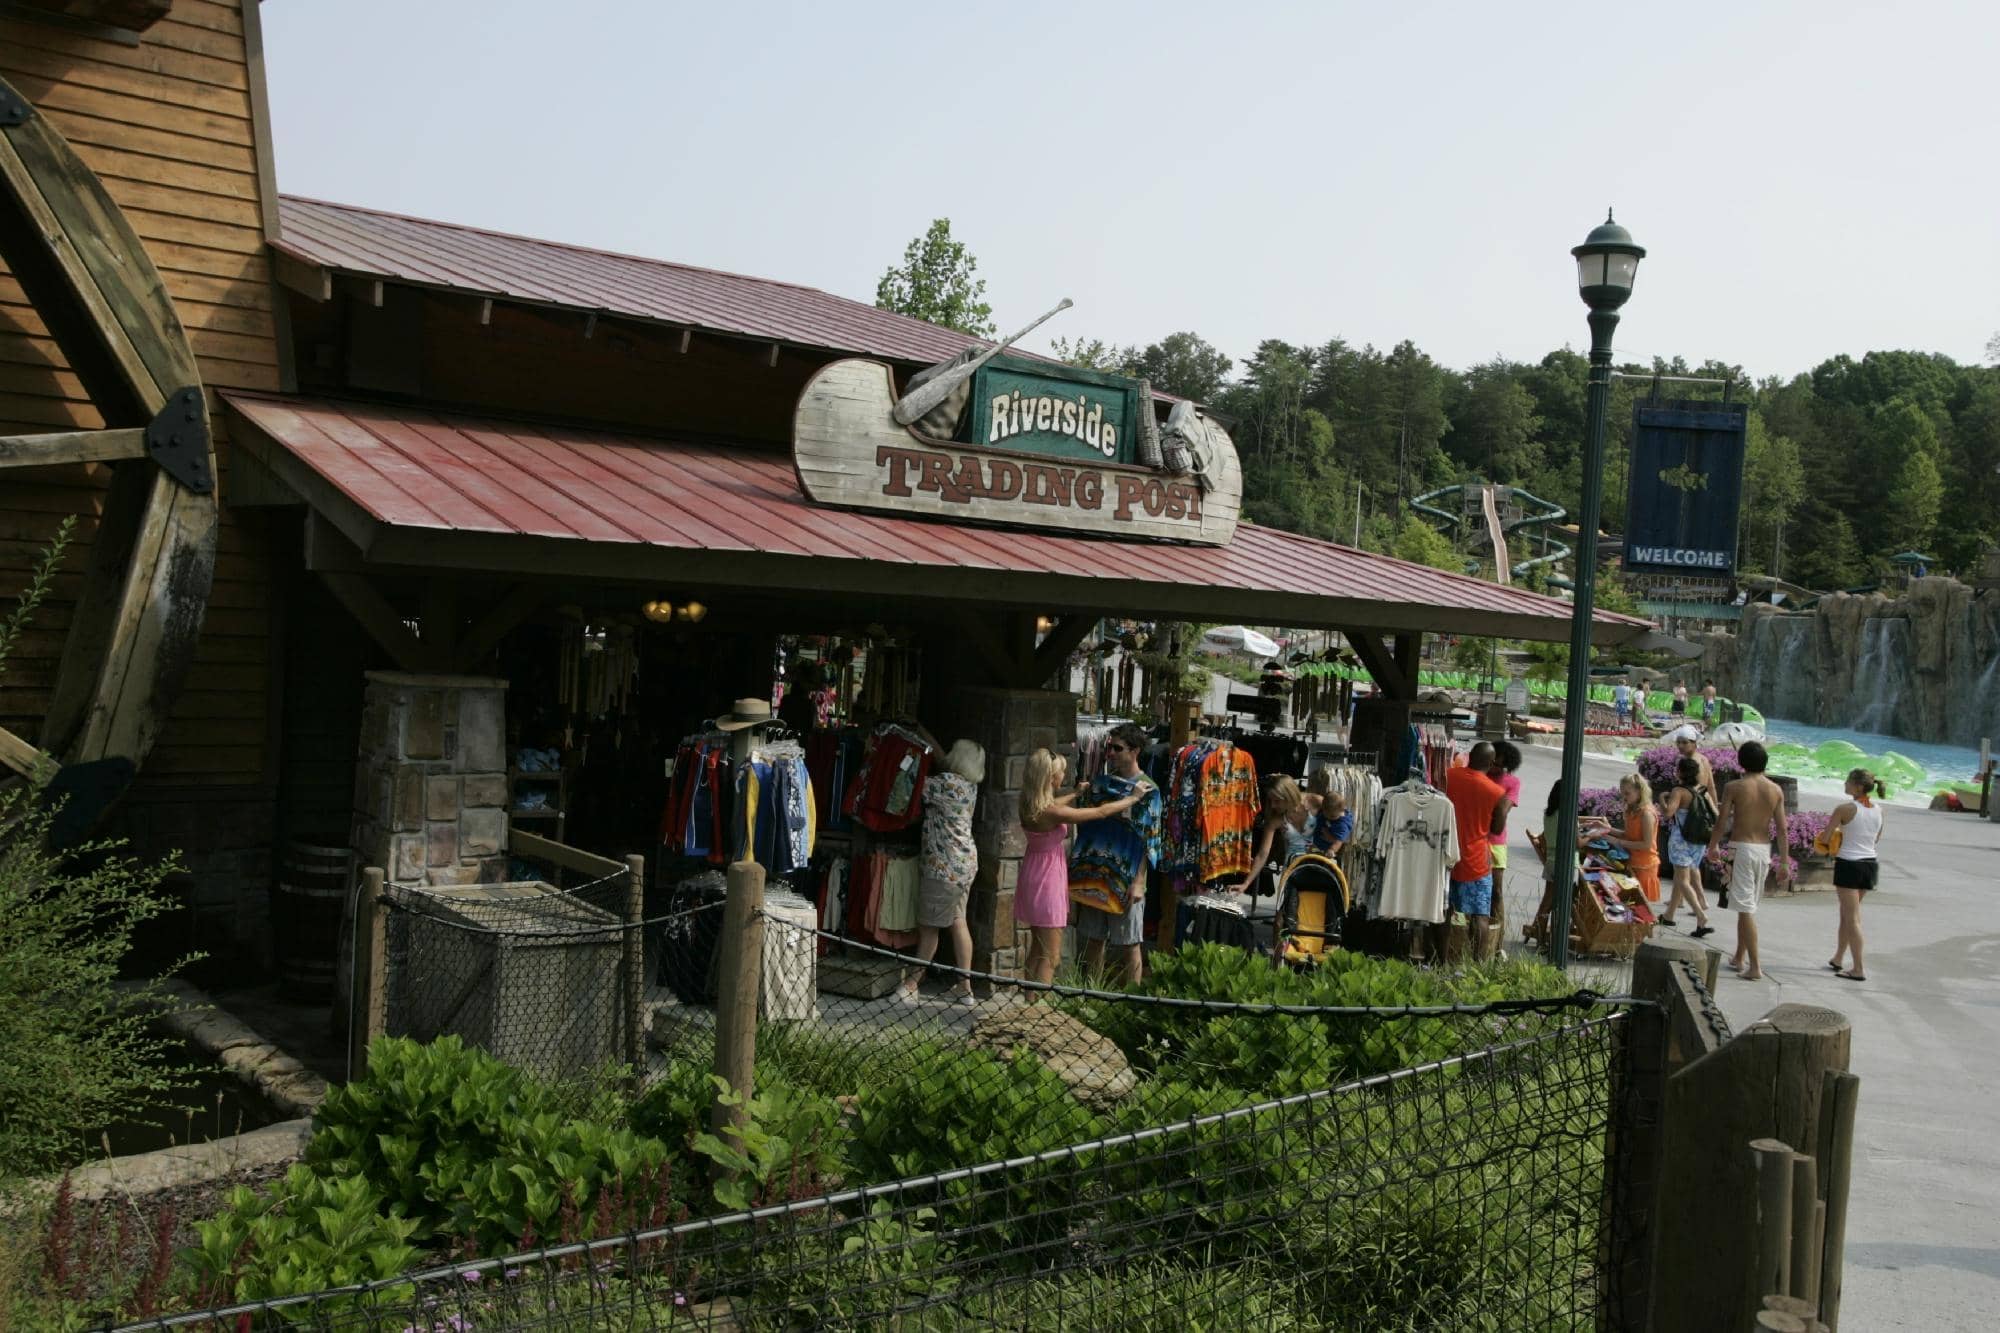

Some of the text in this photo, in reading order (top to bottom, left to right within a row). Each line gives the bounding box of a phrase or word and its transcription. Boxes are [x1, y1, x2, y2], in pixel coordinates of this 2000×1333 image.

[989, 391, 1116, 457] Riverside
[876, 445, 1205, 522] TRADING POST
[1636, 547, 1725, 566] WELCOME
